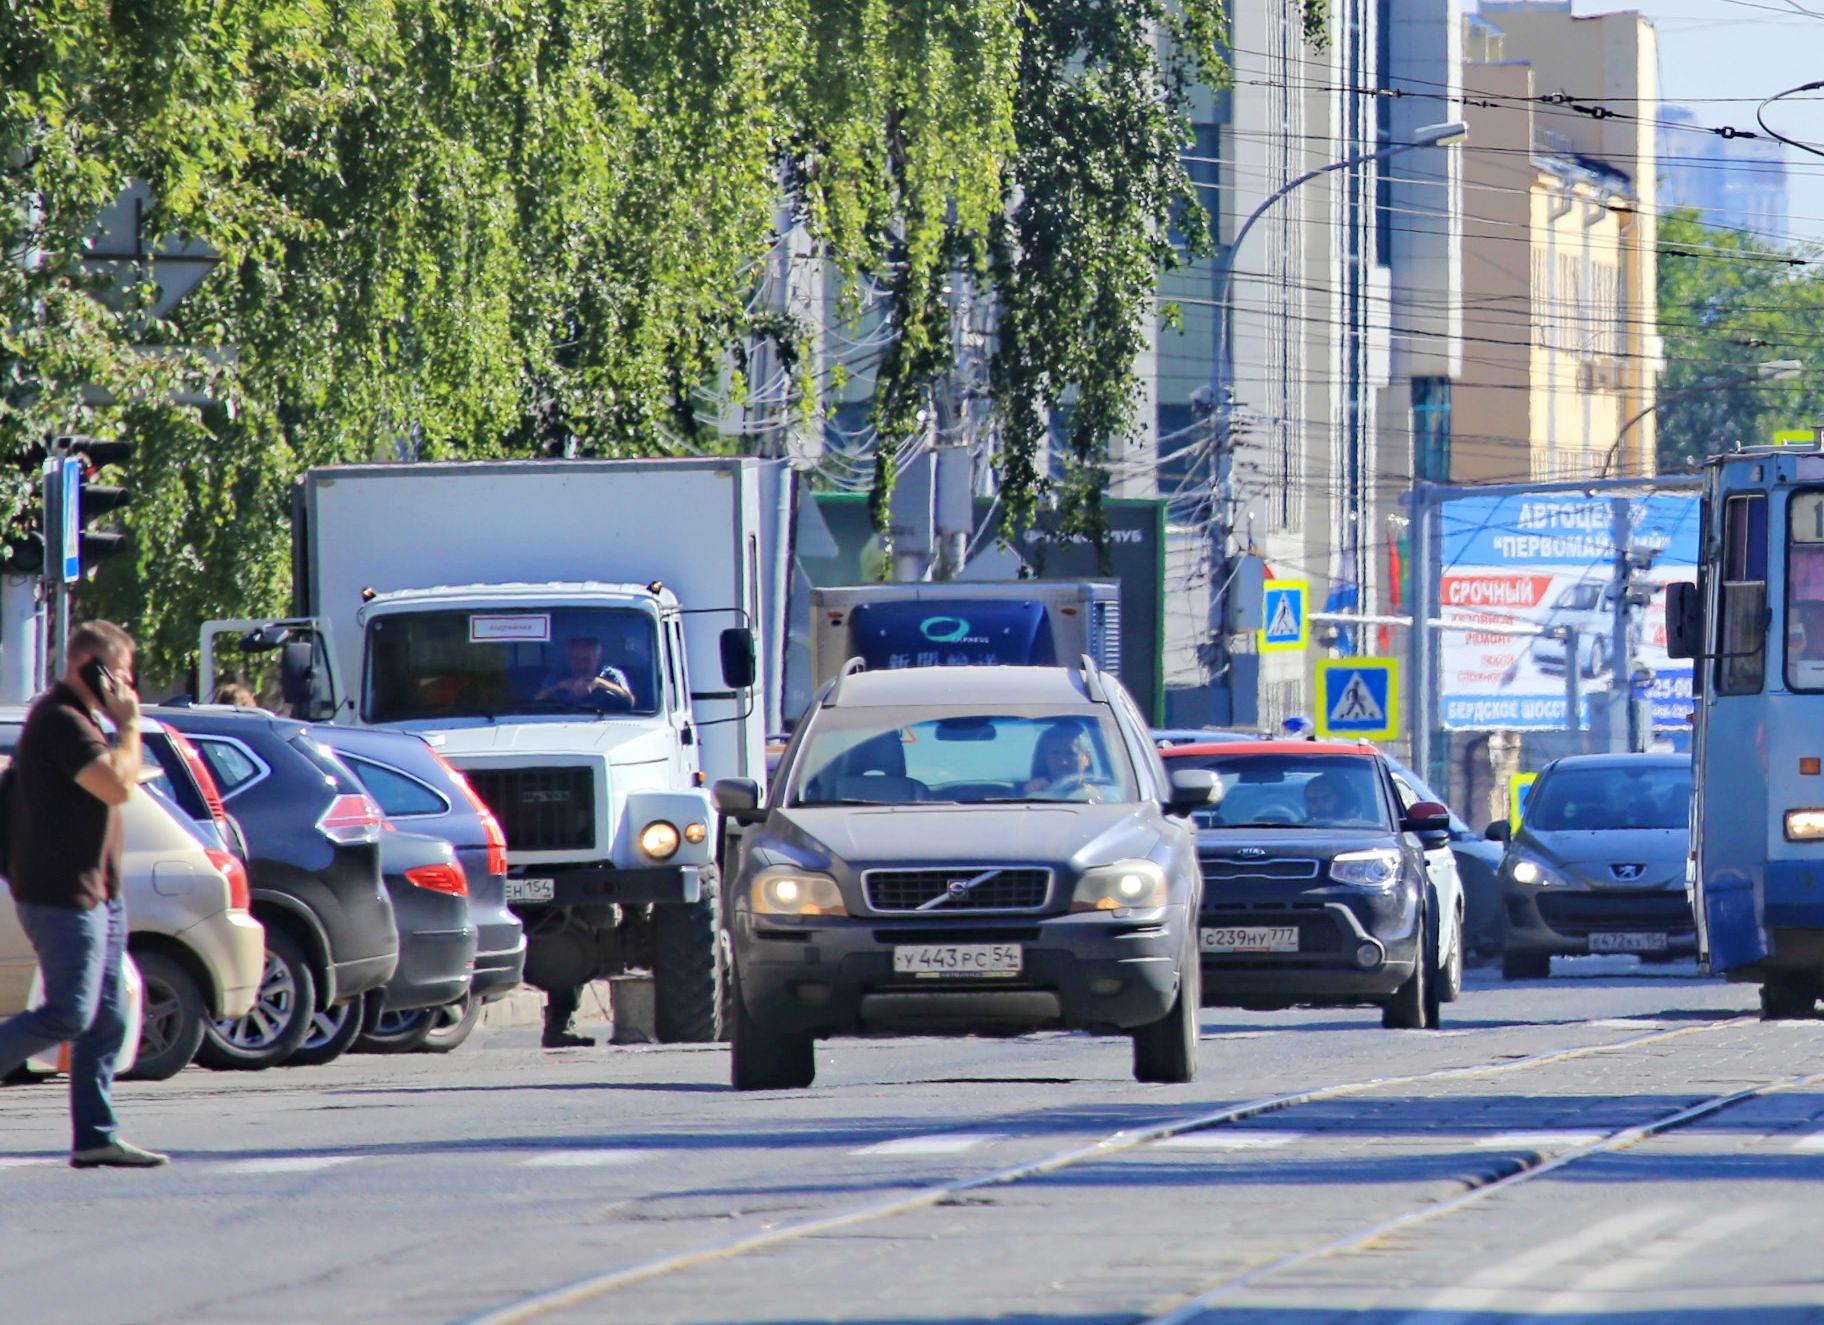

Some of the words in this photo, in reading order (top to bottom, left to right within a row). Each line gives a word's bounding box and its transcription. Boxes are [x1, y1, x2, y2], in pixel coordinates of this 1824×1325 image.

[1449, 580, 1534, 603] СРОЧНЫЙ
[1447, 701, 1518, 722] БЕРДСКОЕ
[526, 881, 551, 893] 154
[1271, 928, 1294, 941] 777
[992, 947, 1014, 961] 54
